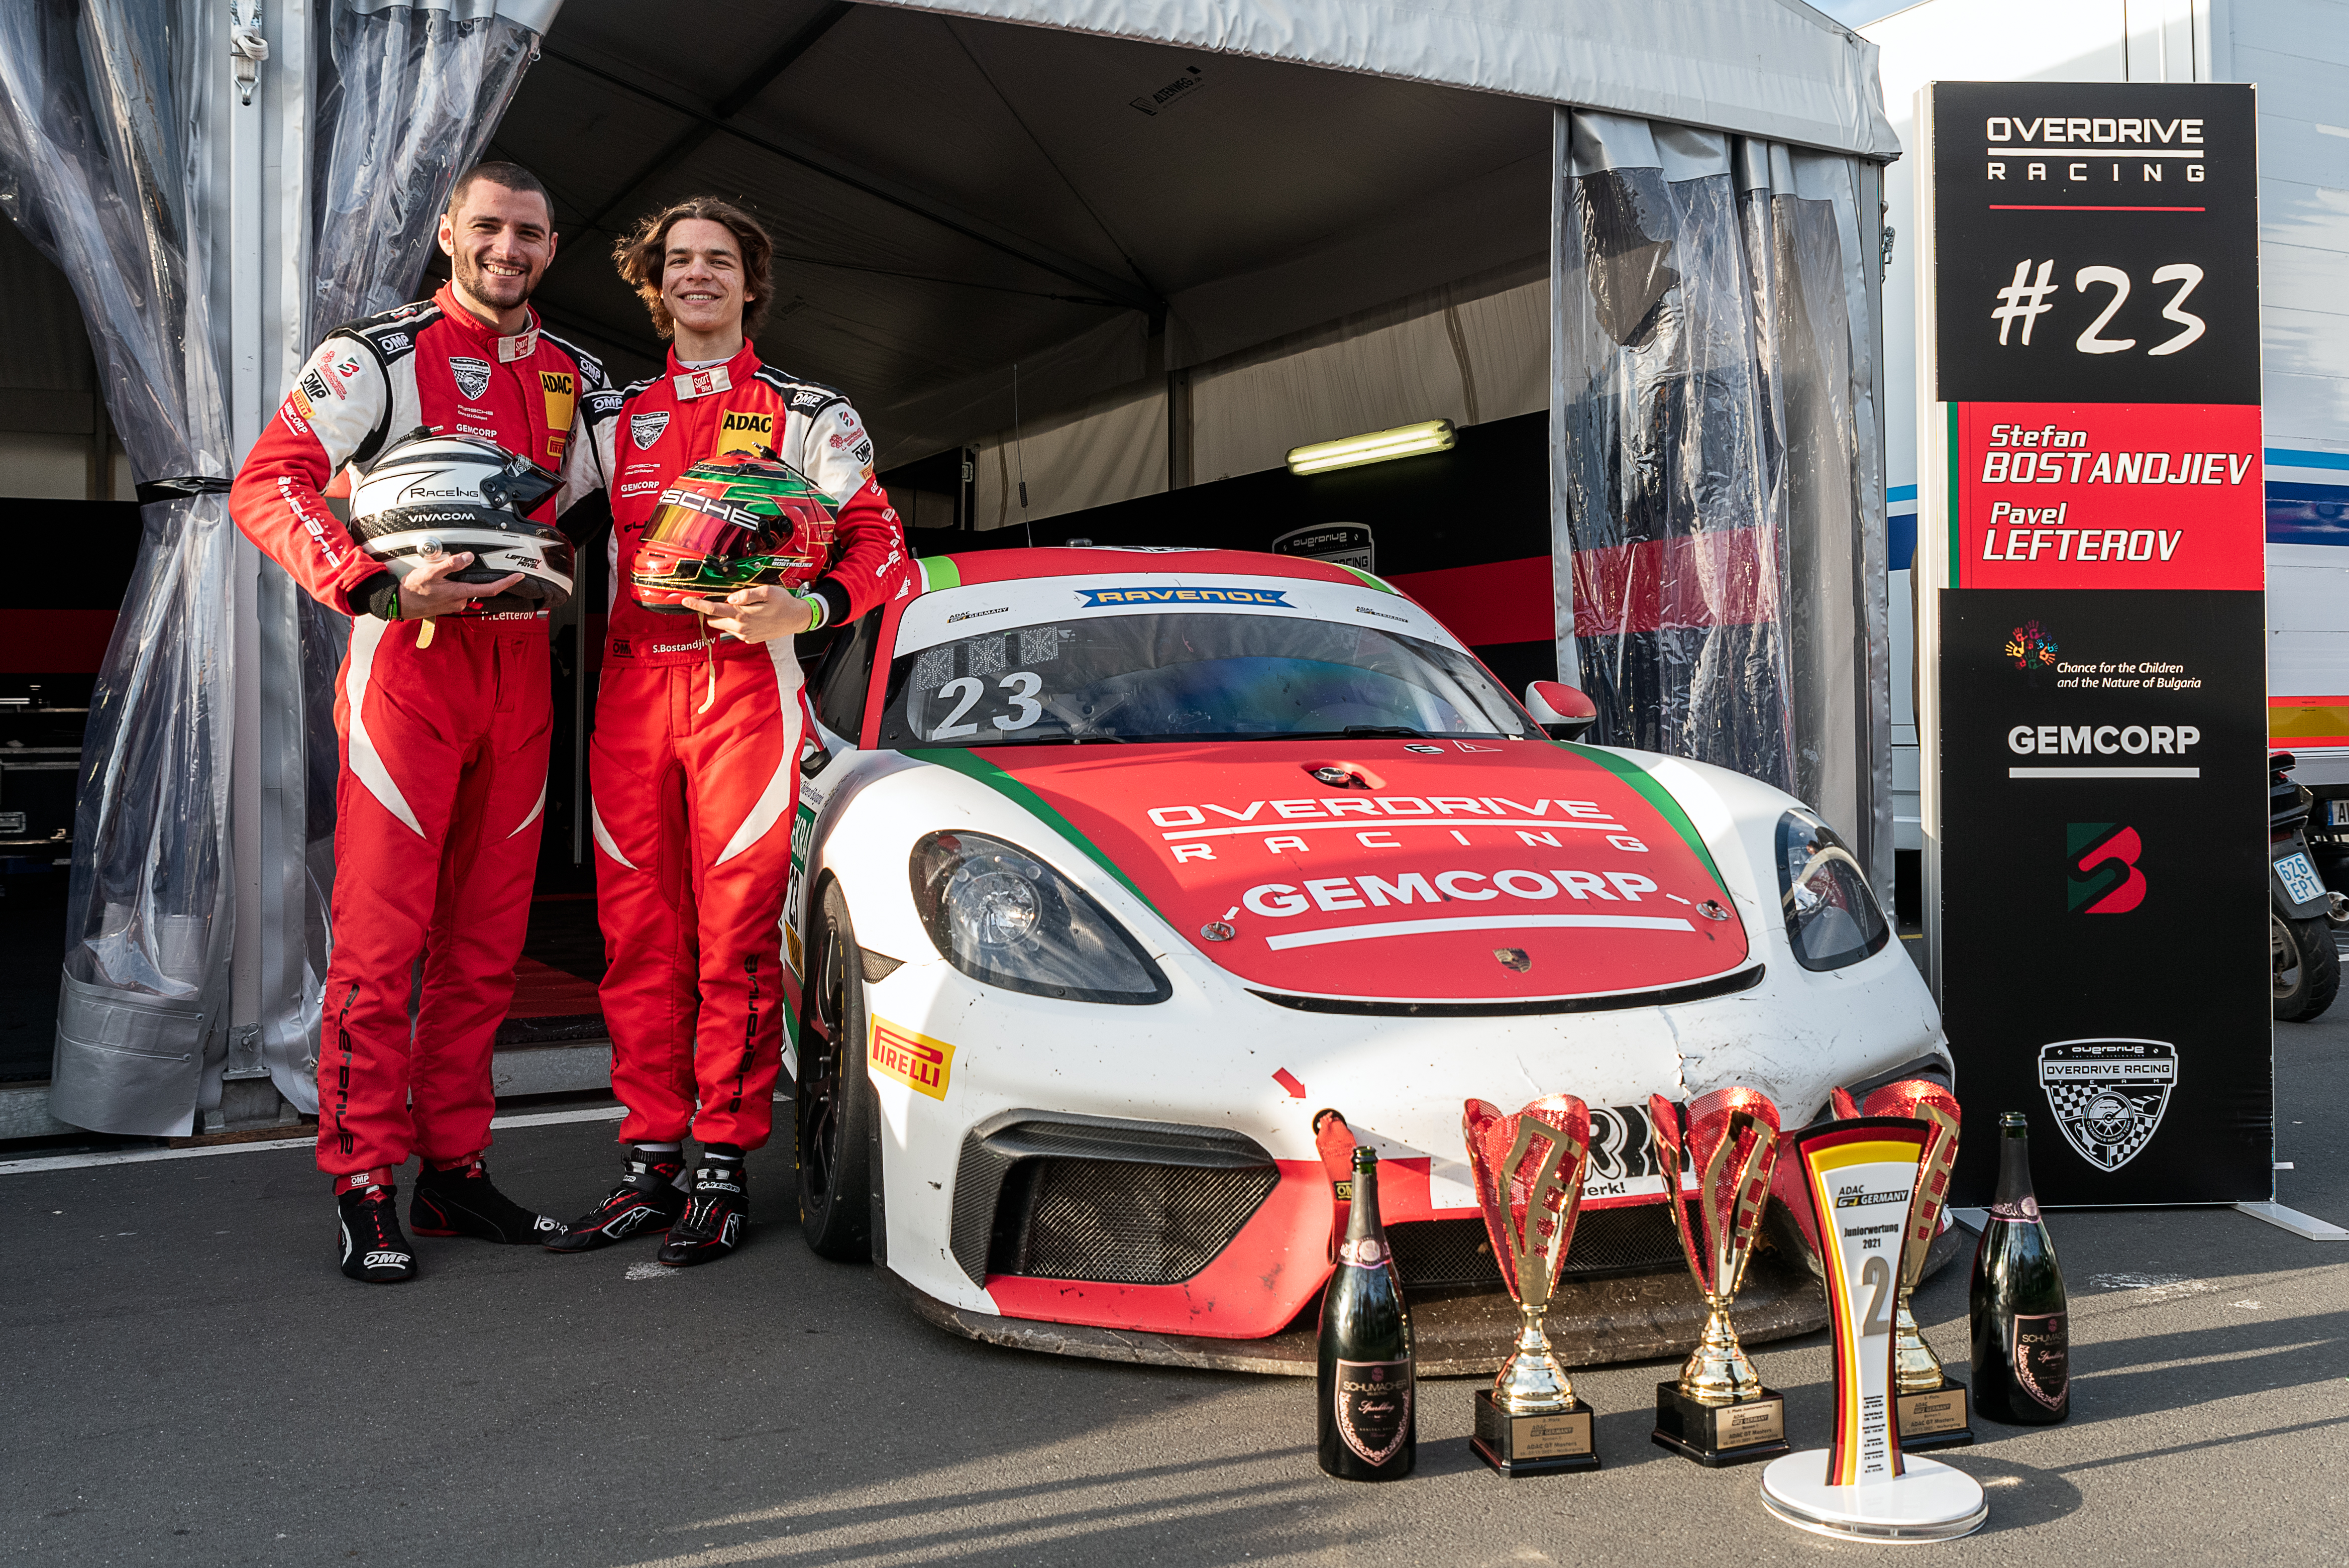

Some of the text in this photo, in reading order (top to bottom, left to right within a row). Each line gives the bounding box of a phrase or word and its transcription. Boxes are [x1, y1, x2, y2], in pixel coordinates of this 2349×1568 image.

[1152, 77, 1194, 104] ALTENWEG
[1987, 117, 2204, 143] OVERDRIVE
[1987, 162, 2205, 182] RACING
[1991, 259, 2206, 356] #23
[382, 335, 409, 351] OMP
[515, 337, 528, 351] Sport
[580, 360, 601, 380] OMP
[304, 373, 327, 398] OMP
[542, 374, 572, 395] ADAC
[694, 373, 710, 389] Sport
[701, 384, 712, 392] Bild
[293, 389, 311, 415] PIRELLI
[594, 397, 623, 410] OMP
[793, 393, 821, 404] OMP
[284, 402, 308, 434] GEMCORP
[722, 413, 772, 433] ADAC
[456, 424, 497, 438] GEMCORP
[1989, 424, 2087, 448] Stefan
[856, 442, 871, 462] OMP
[1981, 452, 2254, 485] BOSTANDJIEV
[620, 481, 660, 492] GEMCORP
[408, 513, 475, 522] VIVACOM
[1990, 501, 2067, 525] Pavel
[1982, 529, 2183, 561] LEFTEROV
[505, 553, 542, 564] LEFTEROV
[517, 561, 539, 569] PAVEL
[1097, 590, 1276, 603] RAVENOL
[969, 607, 1007, 618] GERMANY
[613, 643, 632, 655] OM
[2057, 662, 2183, 674] Chance for the Children
[2057, 677, 2201, 690] and the Nature of Bulgaria
[932, 672, 1042, 741] 23
[2008, 725, 2200, 755] GEMCORP
[1146, 796, 1615, 827] OVERDRIVE
[791, 813, 811, 862] EKRA
[1169, 830, 1649, 863] RACING
[2279, 857, 2308, 881] 626
[1242, 869, 1658, 918] GEMCORP
[2290, 876, 2319, 900] EPT
[873, 1024, 944, 1088] PIRELLI
[2047, 1064, 2170, 1075] OVERDRIVE RACING
[2086, 1120, 2131, 1142] OVERDRIVE RACING TEAM
[352, 1175, 369, 1184] OMP
[1337, 1185, 1352, 1196] OM
[1839, 1185, 1864, 1196] ADAC
[1861, 1191, 1907, 1205] GERMANY
[1844, 1223, 1899, 1237] Juniorwertung
[1863, 1238, 1881, 1249] 2021
[364, 1253, 410, 1266] OMP
[1859, 1256, 1891, 1336] 2
